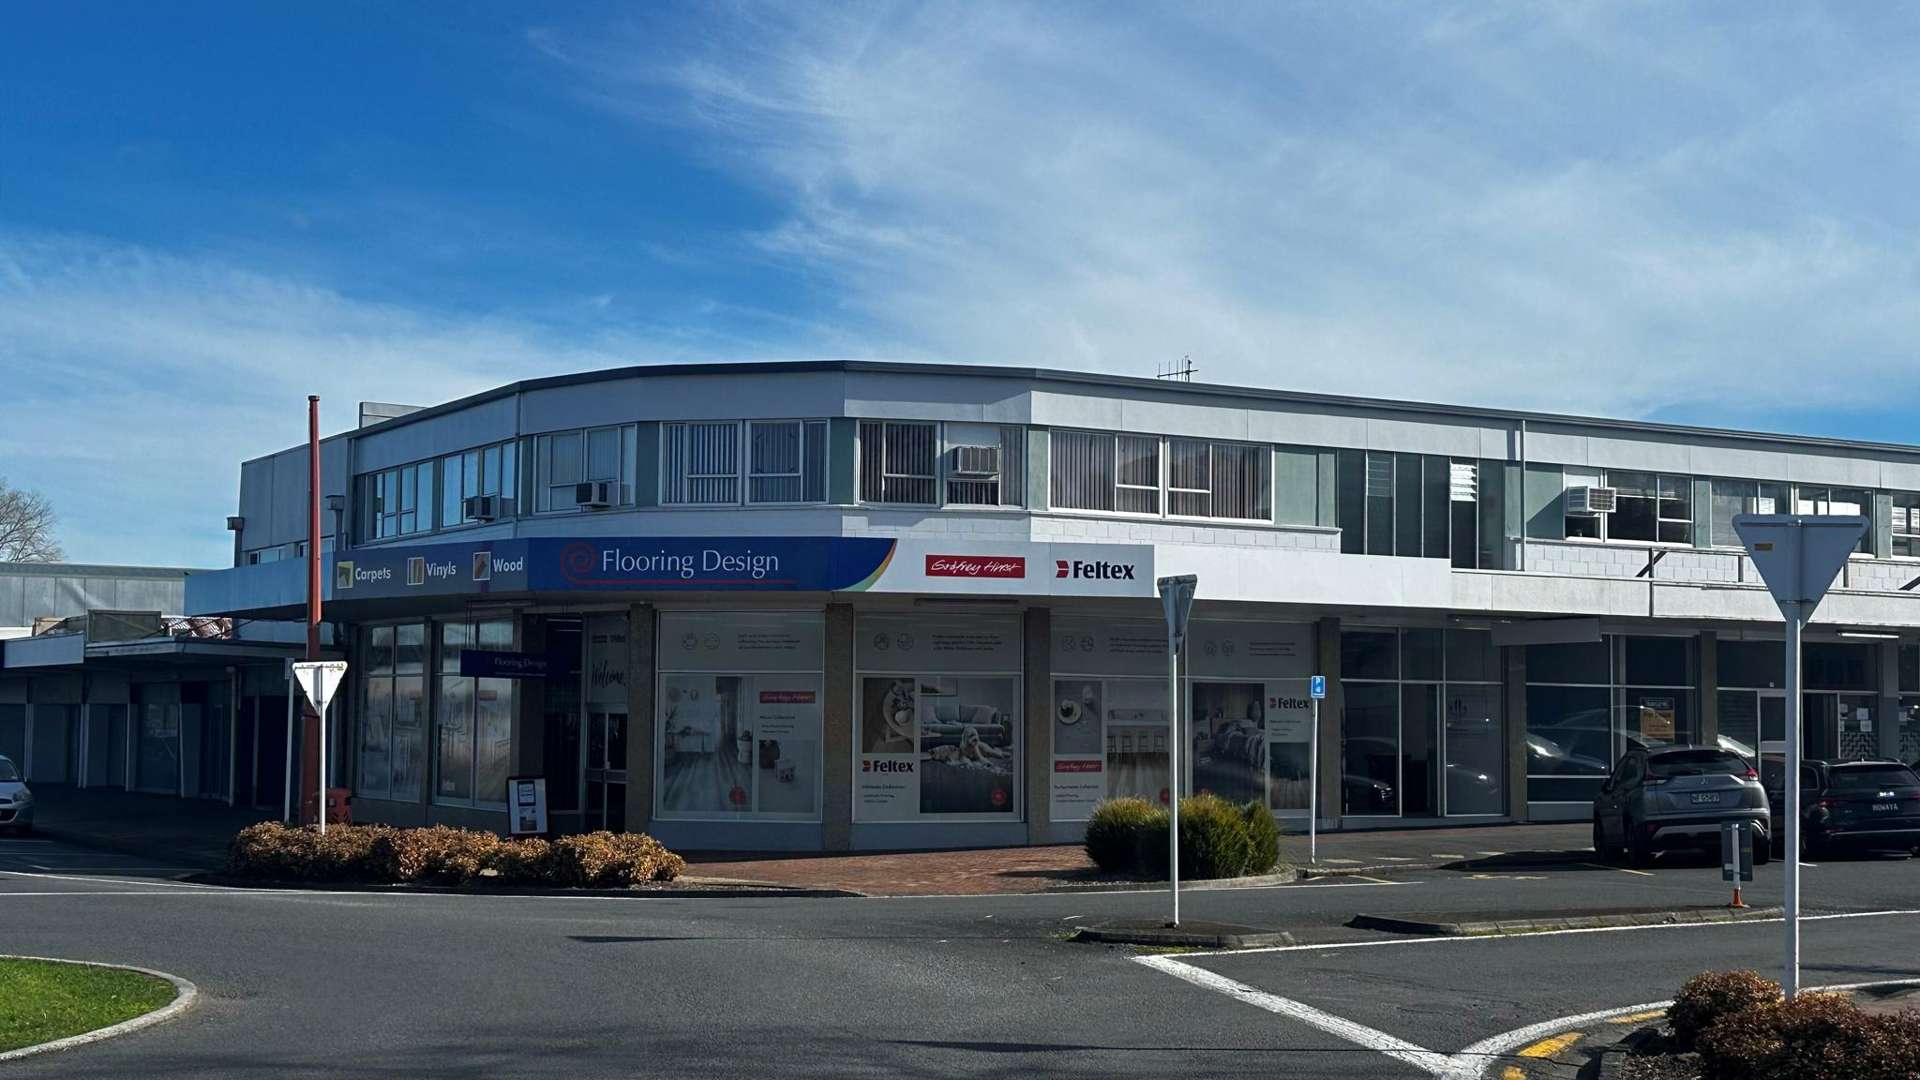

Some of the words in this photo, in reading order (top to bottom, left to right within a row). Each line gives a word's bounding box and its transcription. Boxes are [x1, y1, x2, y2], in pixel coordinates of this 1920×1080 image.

[426, 561, 457, 579] Vinyls
[493, 557, 523, 573] Wood
[602, 548, 694, 579] Flooring
[702, 549, 779, 580] Design
[930, 559, 982, 576] Godfrey
[983, 559, 1022, 574] Hirst
[1073, 560, 1135, 580] Feltex
[355, 567, 391, 583] Carpets
[1278, 697, 1310, 709] Feltex
[873, 760, 914, 773] Feltex
